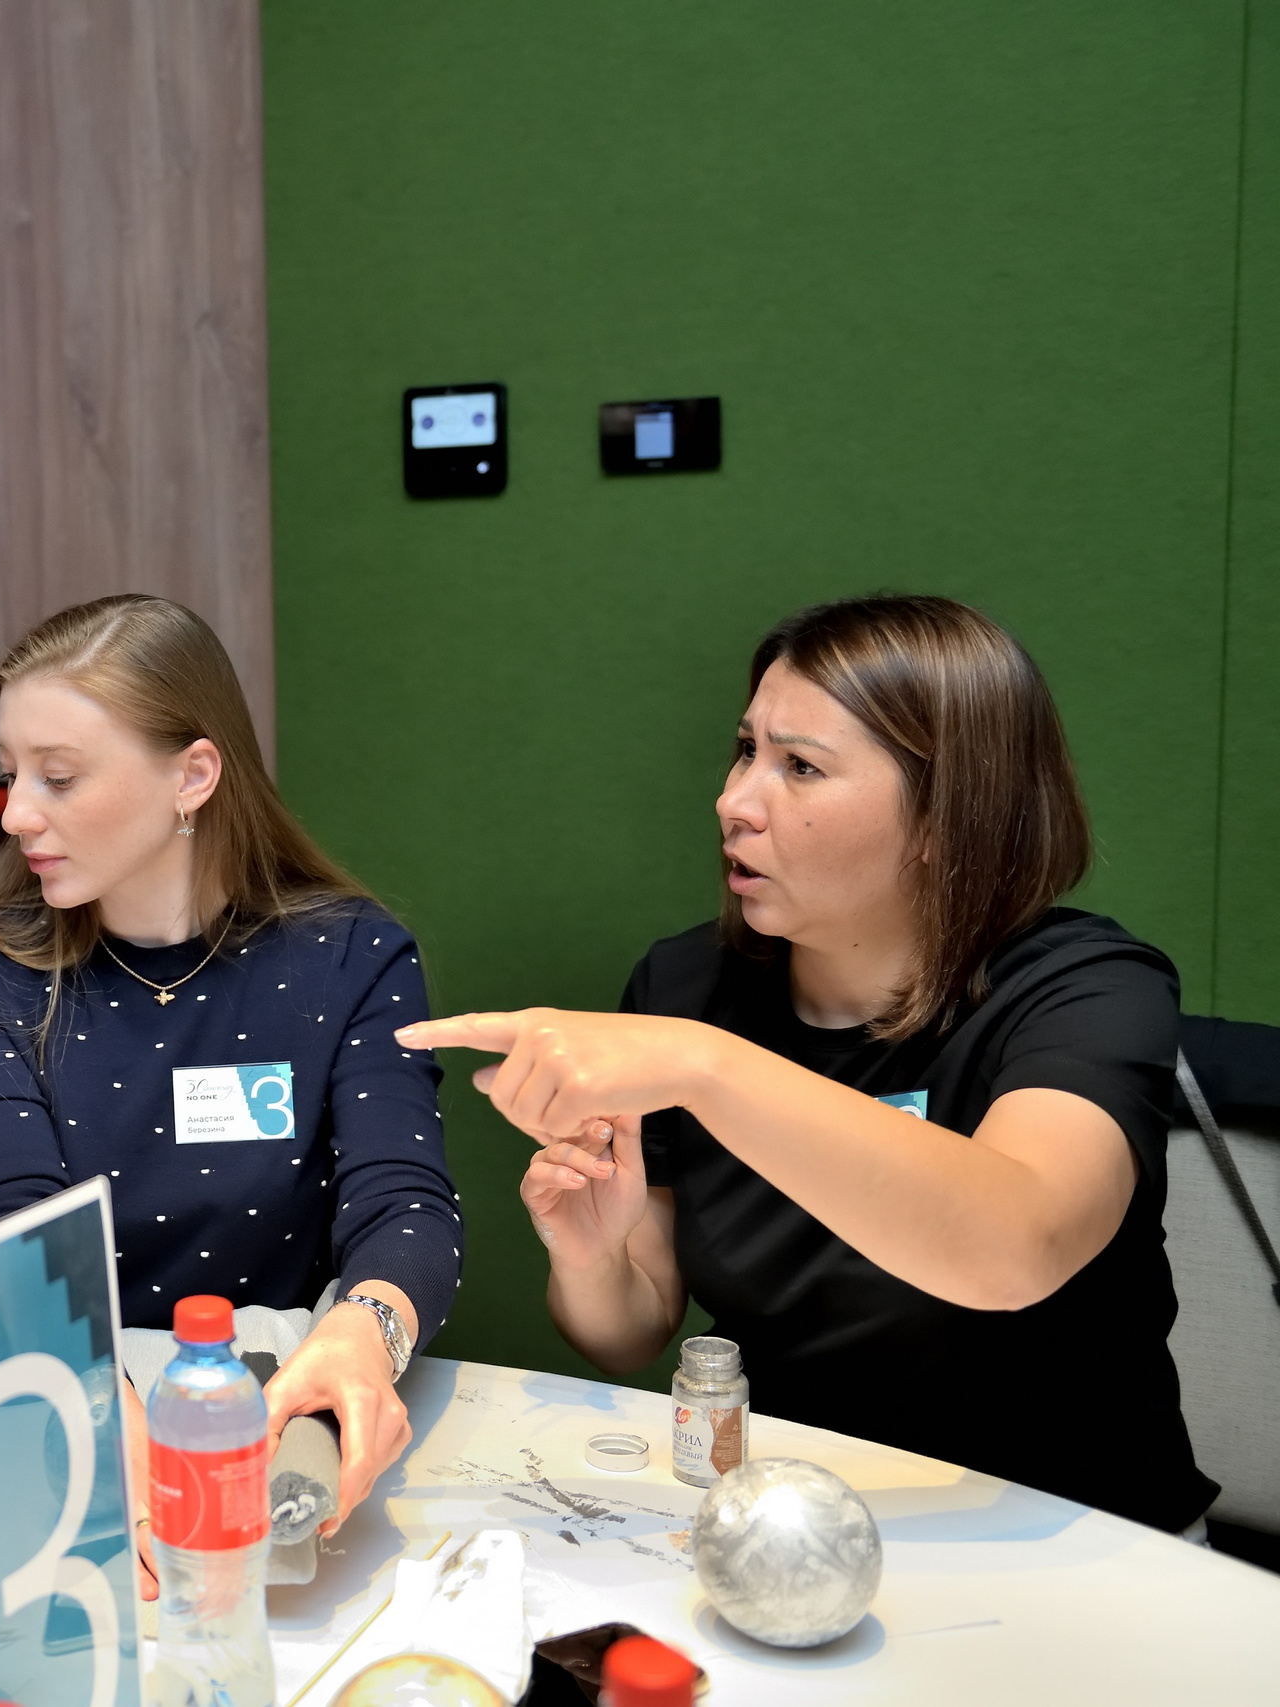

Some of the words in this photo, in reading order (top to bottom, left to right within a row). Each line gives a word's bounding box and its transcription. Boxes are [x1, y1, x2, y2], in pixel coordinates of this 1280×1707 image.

[251, 1075, 295, 1140] 3
[187, 1115, 235, 1124] Анастасия
[187, 1126, 226, 1135] Березина
